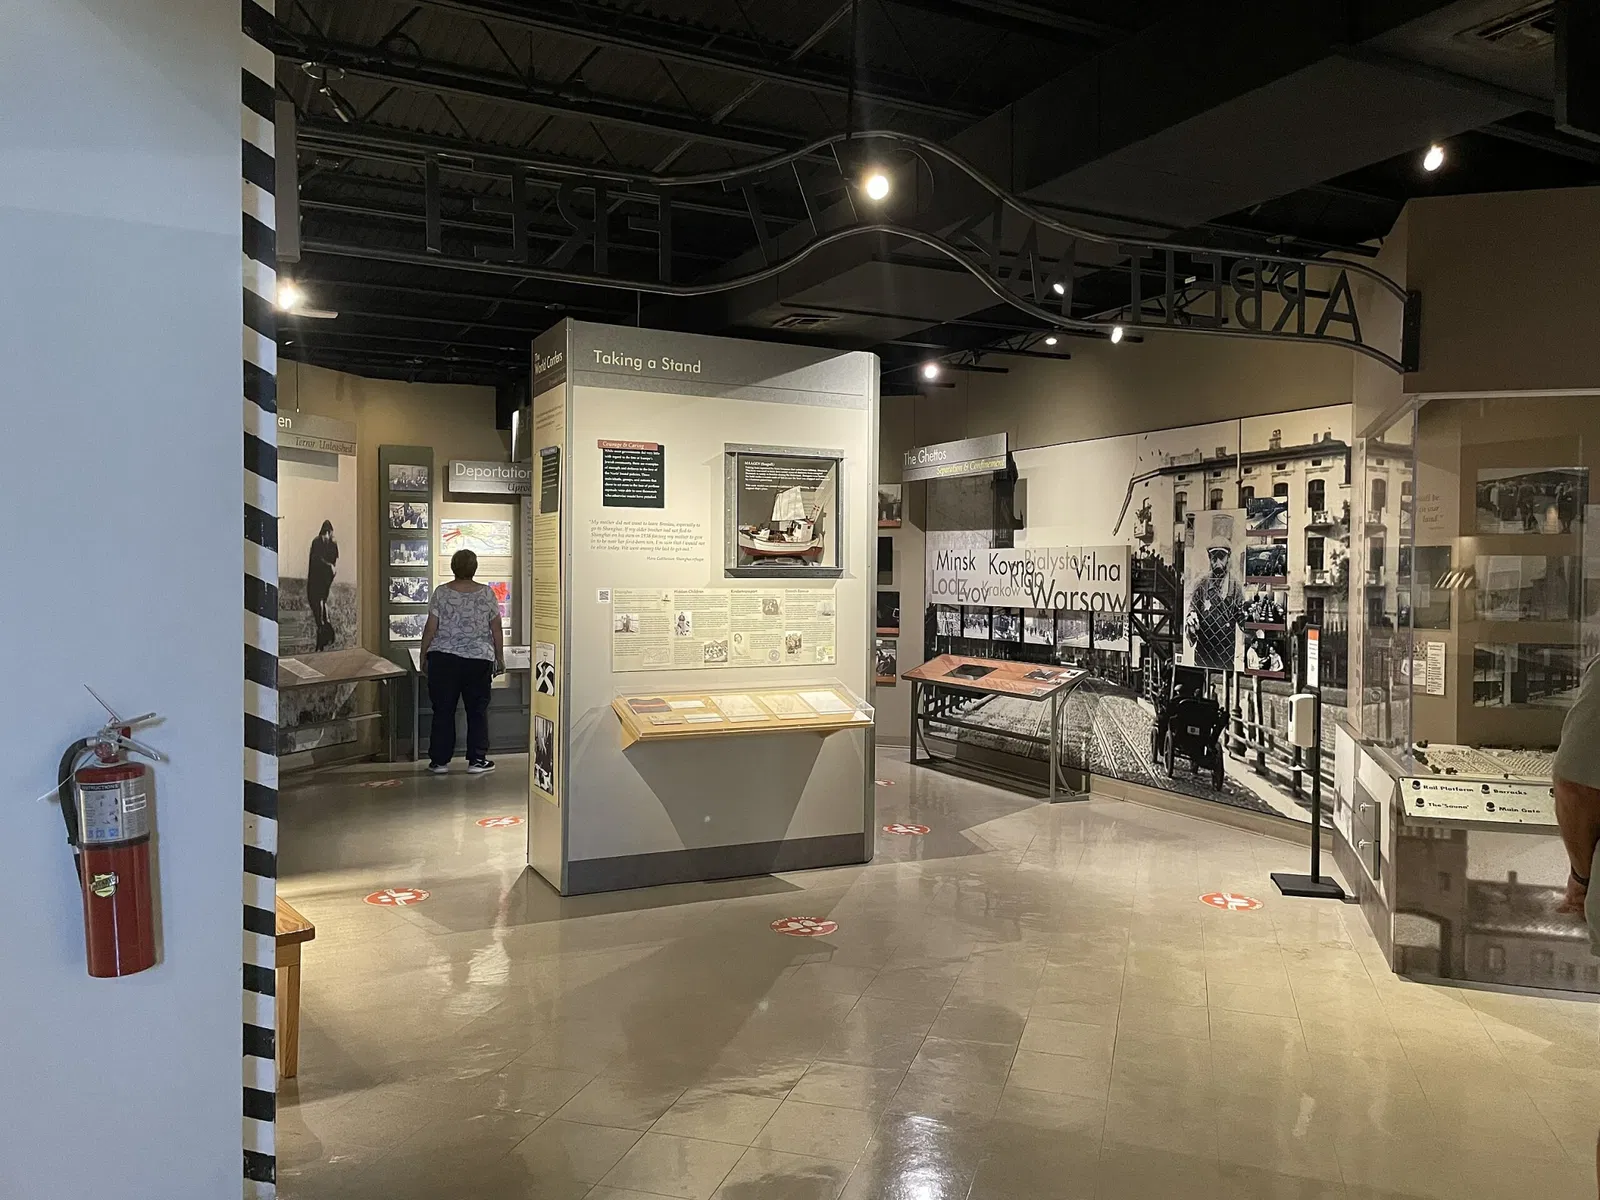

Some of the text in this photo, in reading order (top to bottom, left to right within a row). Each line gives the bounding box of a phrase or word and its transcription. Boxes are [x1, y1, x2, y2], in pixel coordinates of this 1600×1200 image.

[593, 349, 701, 373] Taking a Stand
[277, 416, 292, 429] en
[295, 436, 353, 453] Terror Unleashed
[903, 447, 947, 466] The Ghettos
[936, 549, 1121, 581] Minsk Kovno Vilna
[932, 566, 968, 595] Lodz
[957, 578, 1127, 613] Lvov Krakow Warsaw
